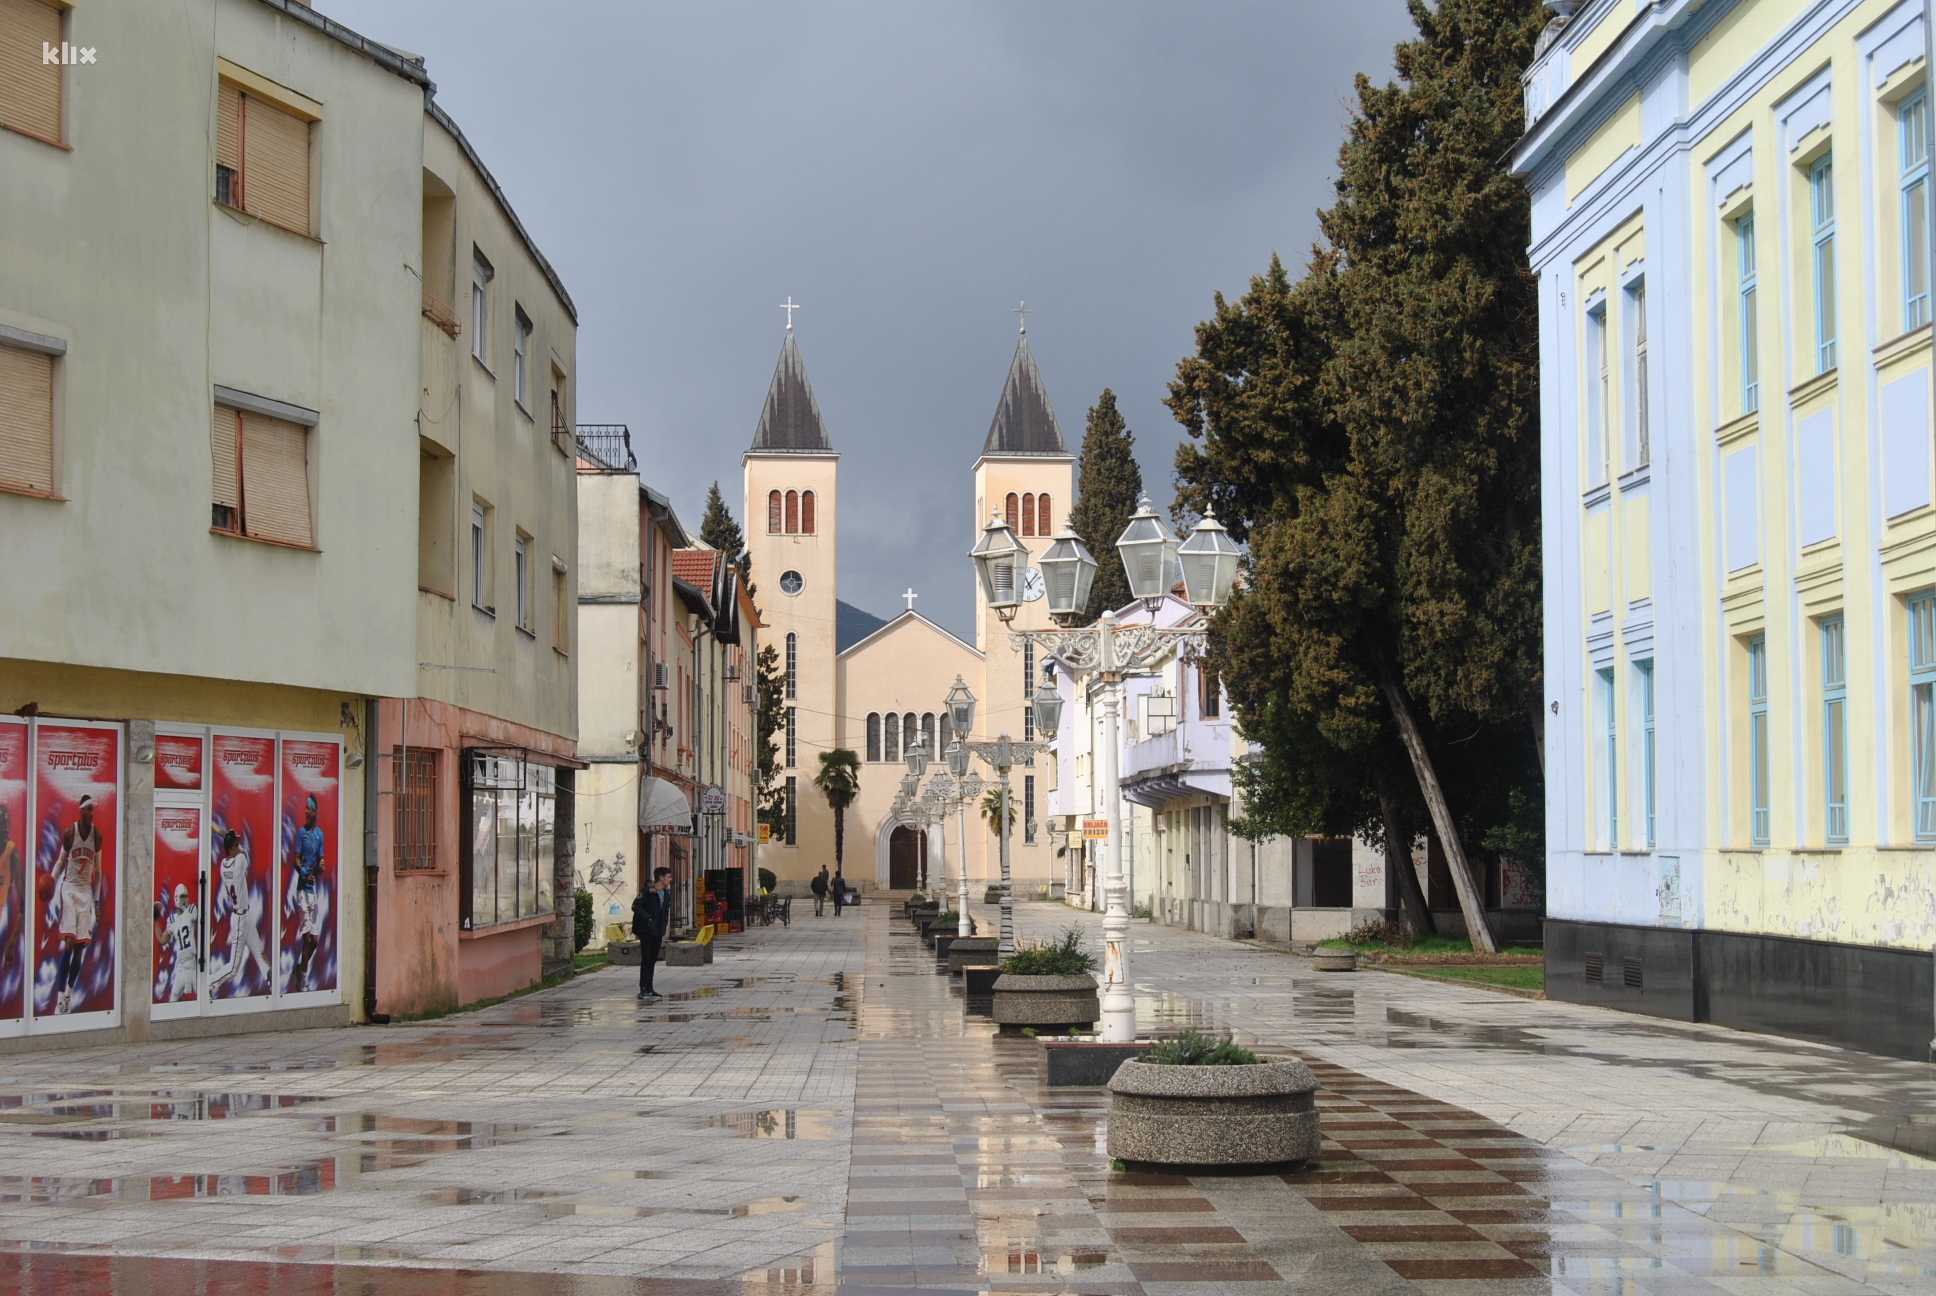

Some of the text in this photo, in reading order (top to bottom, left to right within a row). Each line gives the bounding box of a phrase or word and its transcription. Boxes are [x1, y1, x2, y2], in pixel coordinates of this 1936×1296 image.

[48, 751, 99, 770] sportplus
[160, 753, 193, 767] sportplus
[223, 749, 260, 765] sportplus
[292, 753, 326, 768] sportplus
[161, 818, 193, 831] sportplus
[77, 858, 88, 875] 7
[177, 925, 191, 950] 12
